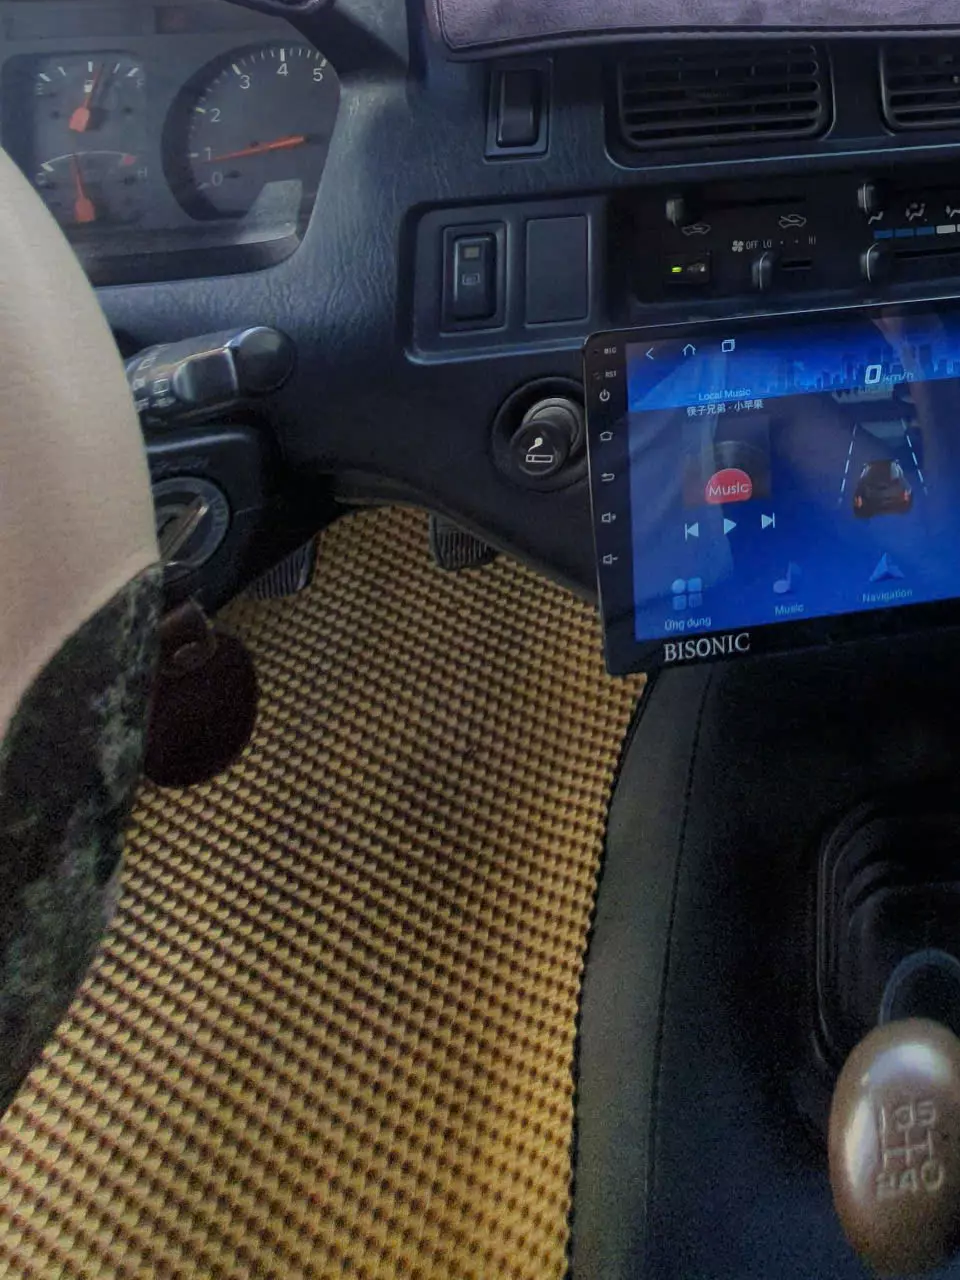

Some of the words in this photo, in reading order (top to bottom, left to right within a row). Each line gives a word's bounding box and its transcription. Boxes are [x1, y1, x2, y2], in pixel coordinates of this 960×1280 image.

[277, 62, 289, 77] 4
[312, 67, 323, 82] 5
[239, 74, 251, 90] 3
[210, 108, 222, 123] 2
[203, 146, 212, 161] 1
[211, 171, 223, 186] 0
[745, 240, 759, 250] OFF
[698, 390, 722, 401] Local
[724, 388, 751, 398] Music
[708, 482, 751, 497] Music
[862, 588, 913, 602] Navigation
[774, 603, 804, 616] Music
[664, 632, 751, 662] BISONIC
